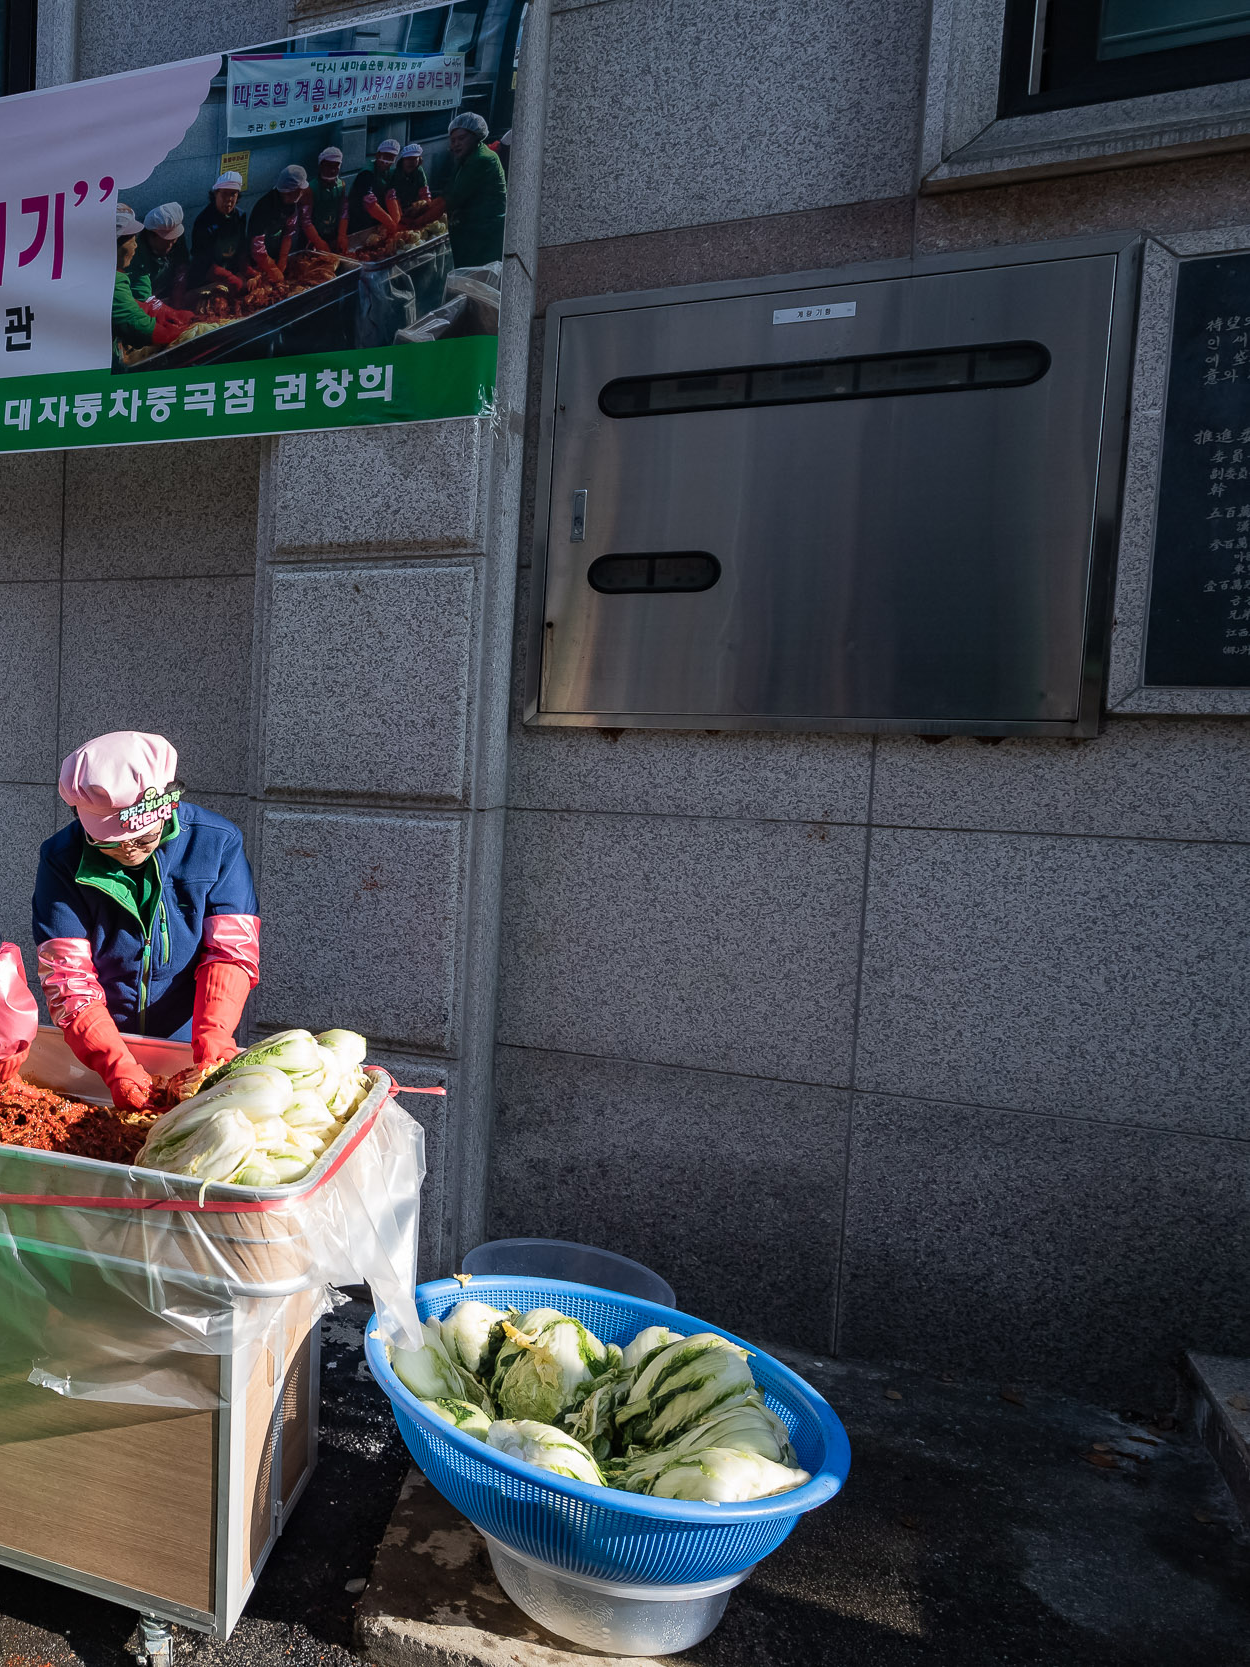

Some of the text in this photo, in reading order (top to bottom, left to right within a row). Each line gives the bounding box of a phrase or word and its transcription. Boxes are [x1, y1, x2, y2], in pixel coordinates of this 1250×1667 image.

[233, 81, 289, 108] 따뜻한
[295, 76, 357, 102] 겨울나기
[361, 74, 395, 93] 사랑의
[272, 364, 394, 411] 권창희
